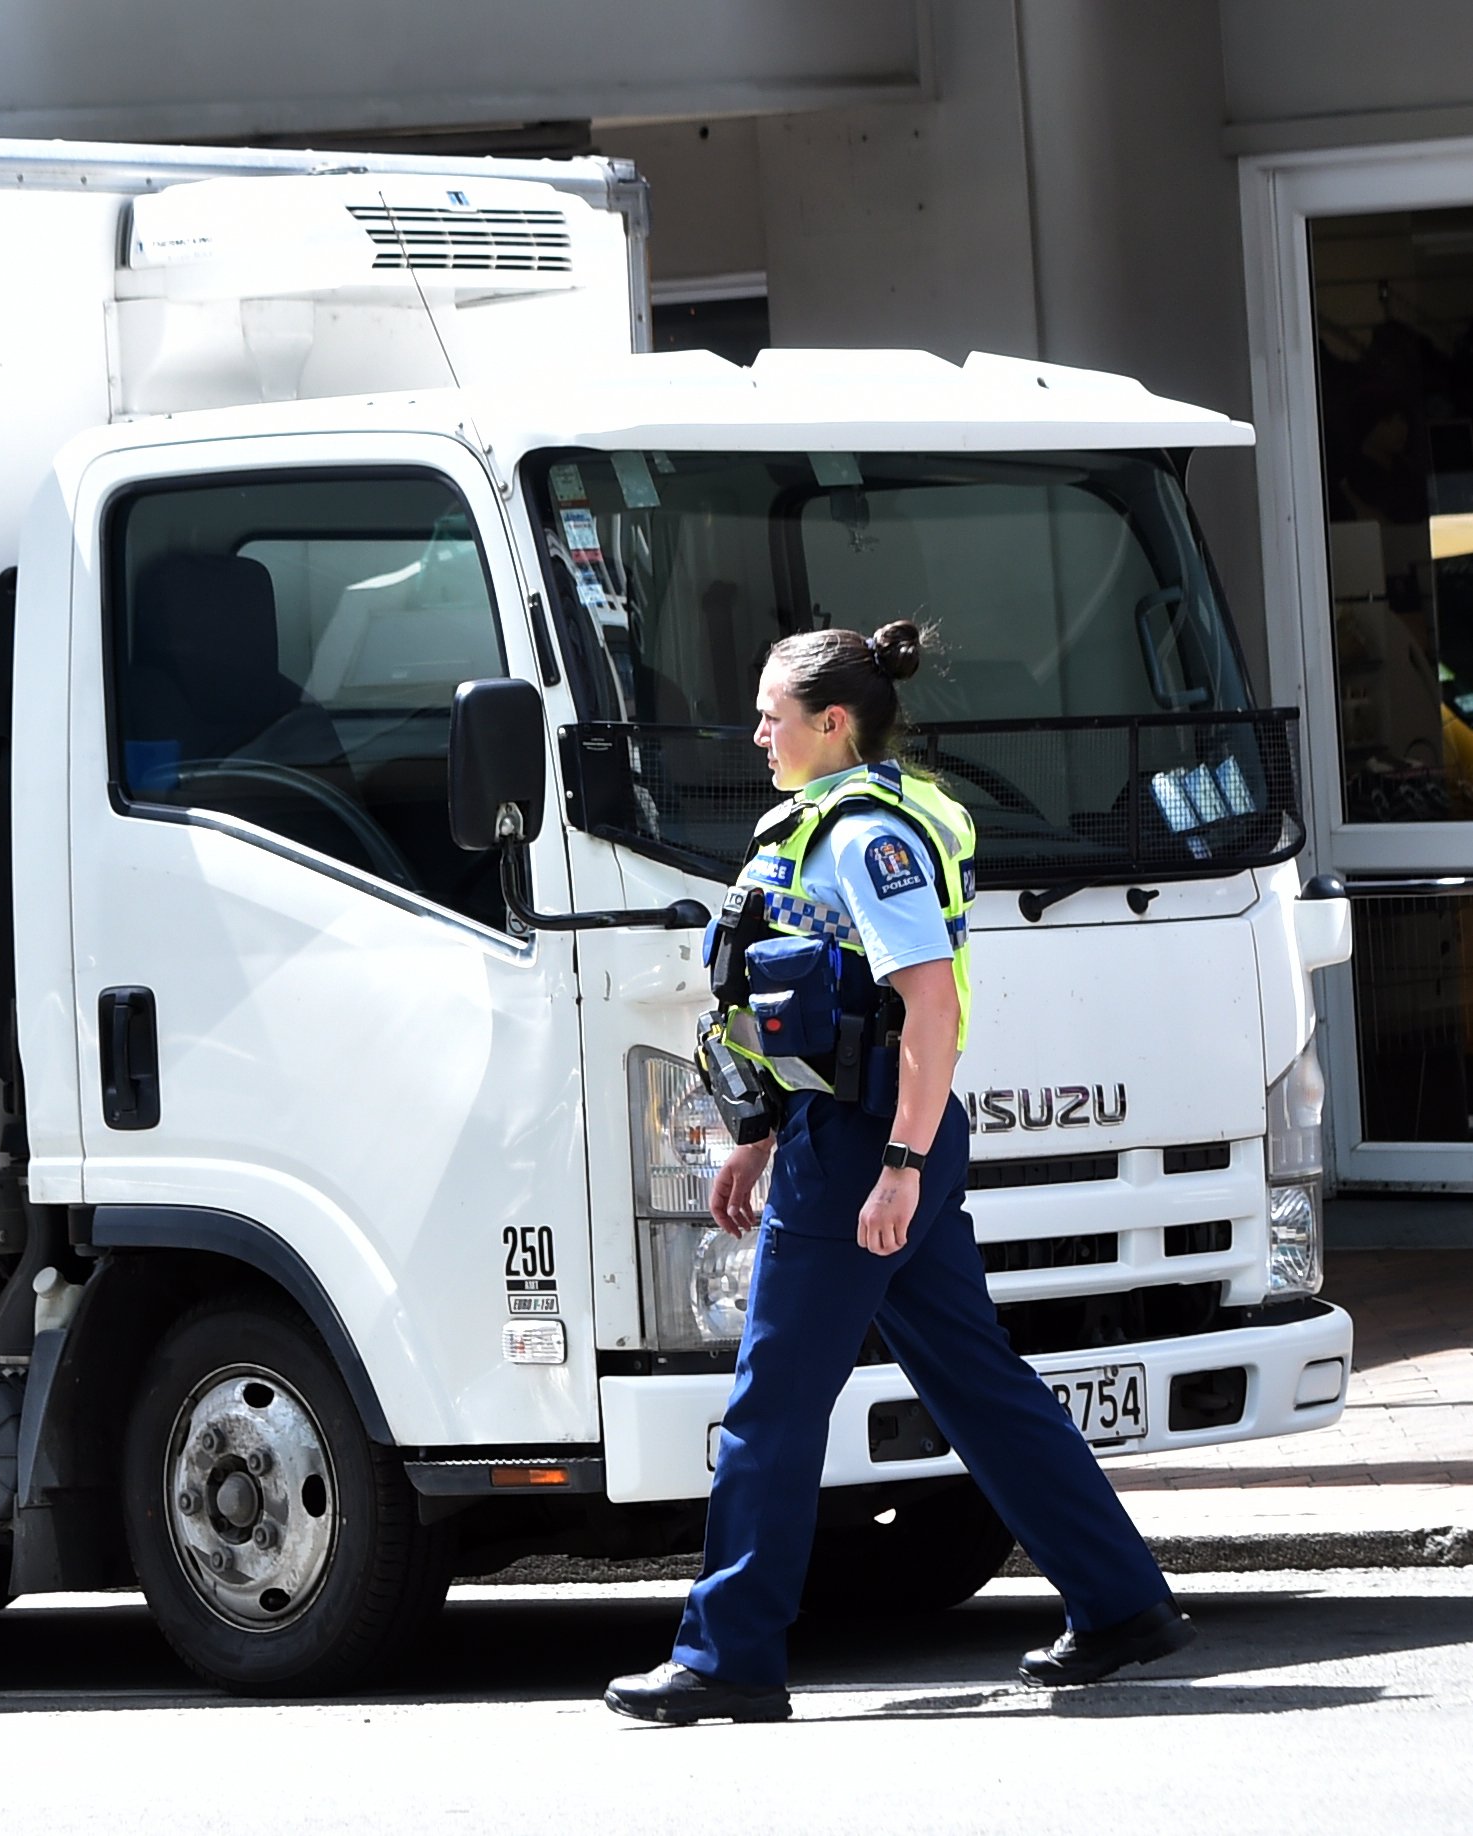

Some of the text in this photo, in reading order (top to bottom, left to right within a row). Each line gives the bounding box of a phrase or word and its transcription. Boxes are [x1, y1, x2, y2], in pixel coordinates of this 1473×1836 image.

[881, 875, 922, 894] POLICE
[964, 1083, 1128, 1134] ISUZU
[502, 1226, 555, 1277] 250
[513, 1298, 532, 1310] EURO
